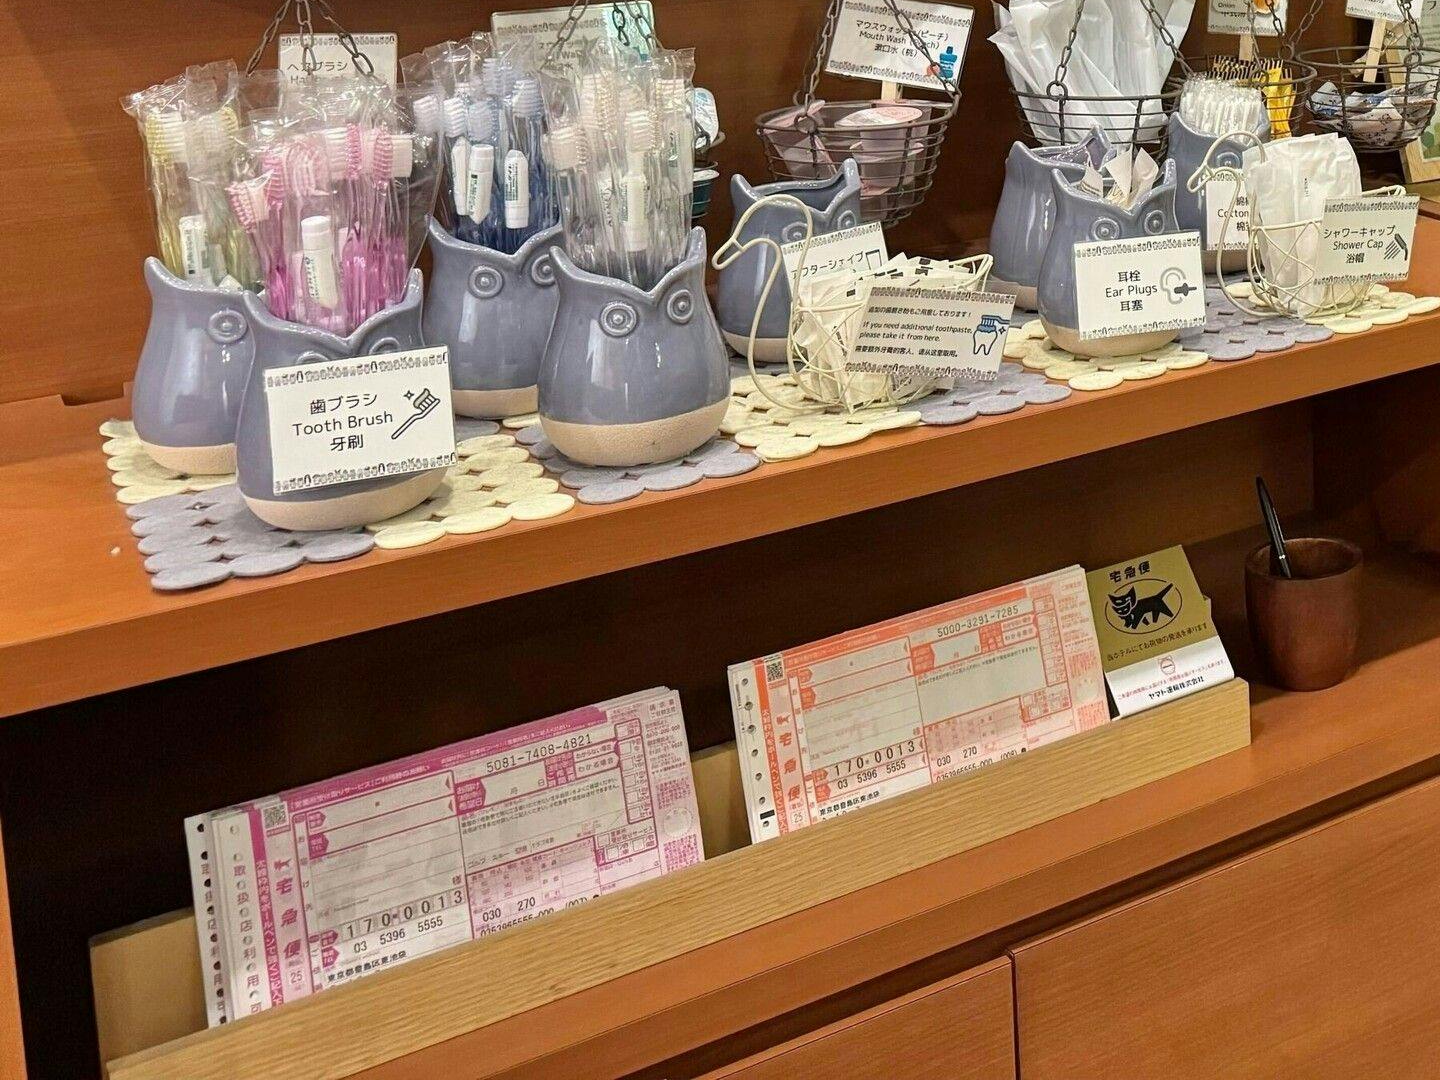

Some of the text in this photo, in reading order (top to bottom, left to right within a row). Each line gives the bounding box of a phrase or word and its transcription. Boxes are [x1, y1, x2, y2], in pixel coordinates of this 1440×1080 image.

[859, 31, 906, 44] Mouth Wash
[1324, 225, 1396, 238] シャワーキャップ
[1333, 238, 1384, 251] Shower Cap
[1118, 270, 1140, 282] 耳栓
[1106, 283, 1158, 297] Ear Plugs
[1120, 299, 1143, 312] 耳塞
[310, 393, 378, 415] 歯ブラシ
[292, 411, 393, 437] Tooth Brush
[330, 434, 364, 452] 牙刷
[1109, 561, 1150, 583] 宅急便
[938, 605, 1019, 638] 5000-3291-7285
[1149, 675, 1204, 699] ヤマト運輸株式会社
[486, 734, 592, 772] 5081-7408-4821
[937, 746, 977, 767] 030 270
[838, 760, 906, 789] 03 5396 5555
[482, 897, 536, 922] 030 270
[354, 916, 443, 954] 03 5396 5555
